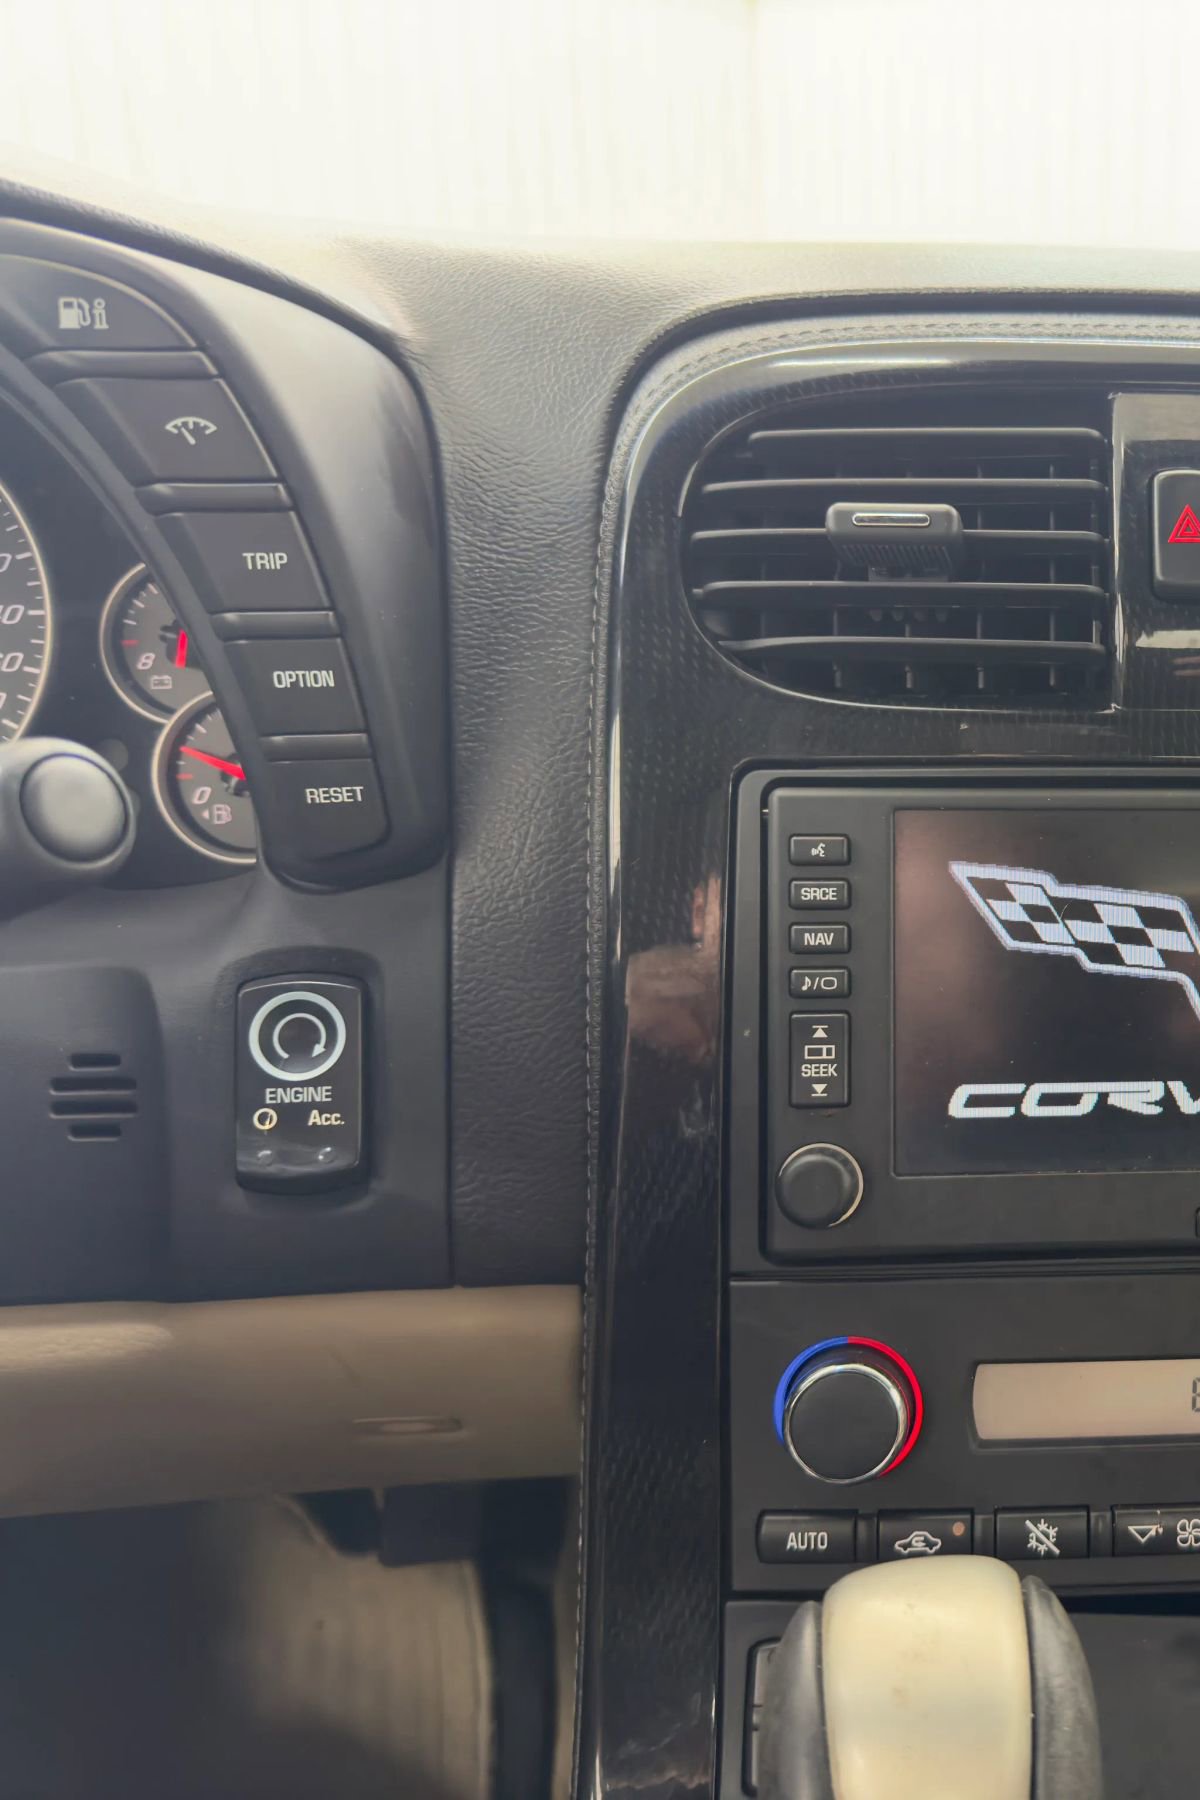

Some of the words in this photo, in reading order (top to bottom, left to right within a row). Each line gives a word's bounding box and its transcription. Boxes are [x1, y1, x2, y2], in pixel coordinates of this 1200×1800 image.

[242, 552, 288, 571] TRIP
[137, 652, 156, 670] 8
[272, 670, 335, 689] OPTION
[305, 786, 364, 804] RESET
[800, 887, 838, 902] SRCE
[804, 932, 834, 946] NAV
[801, 1063, 838, 1078] SEEK
[264, 1086, 333, 1105] ENGINE
[307, 1109, 345, 1127] Acc.
[786, 1531, 828, 1550] AUTO
